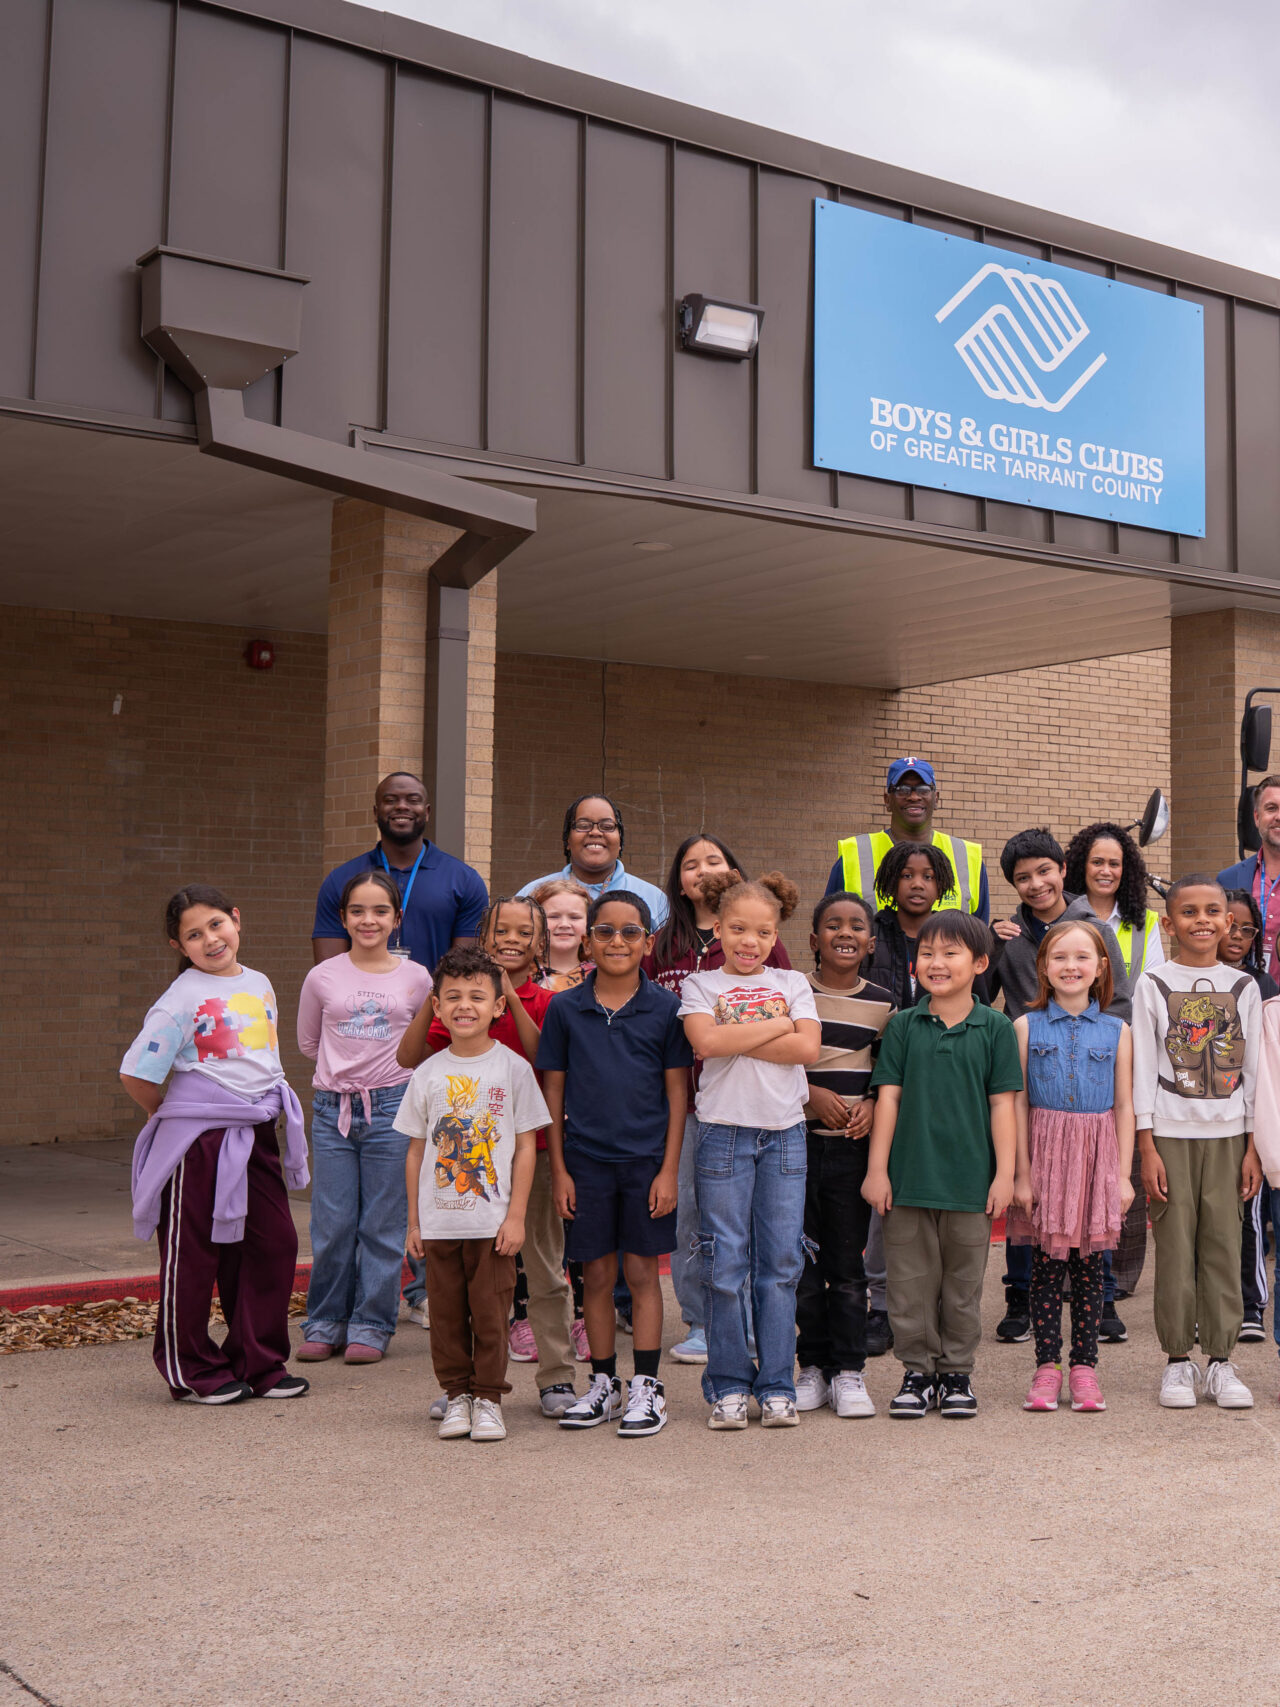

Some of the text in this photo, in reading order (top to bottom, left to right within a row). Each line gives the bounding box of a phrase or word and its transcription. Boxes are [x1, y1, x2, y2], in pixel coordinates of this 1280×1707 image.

[870, 397, 1164, 483] BOYS & GIRLS CLUBS
[870, 430, 1162, 504] OF GREATER TARRANT COUNTY
[904, 756, 918, 766] T
[357, 990, 385, 999] STITCH
[488, 1086, 507, 1117] 悟空
